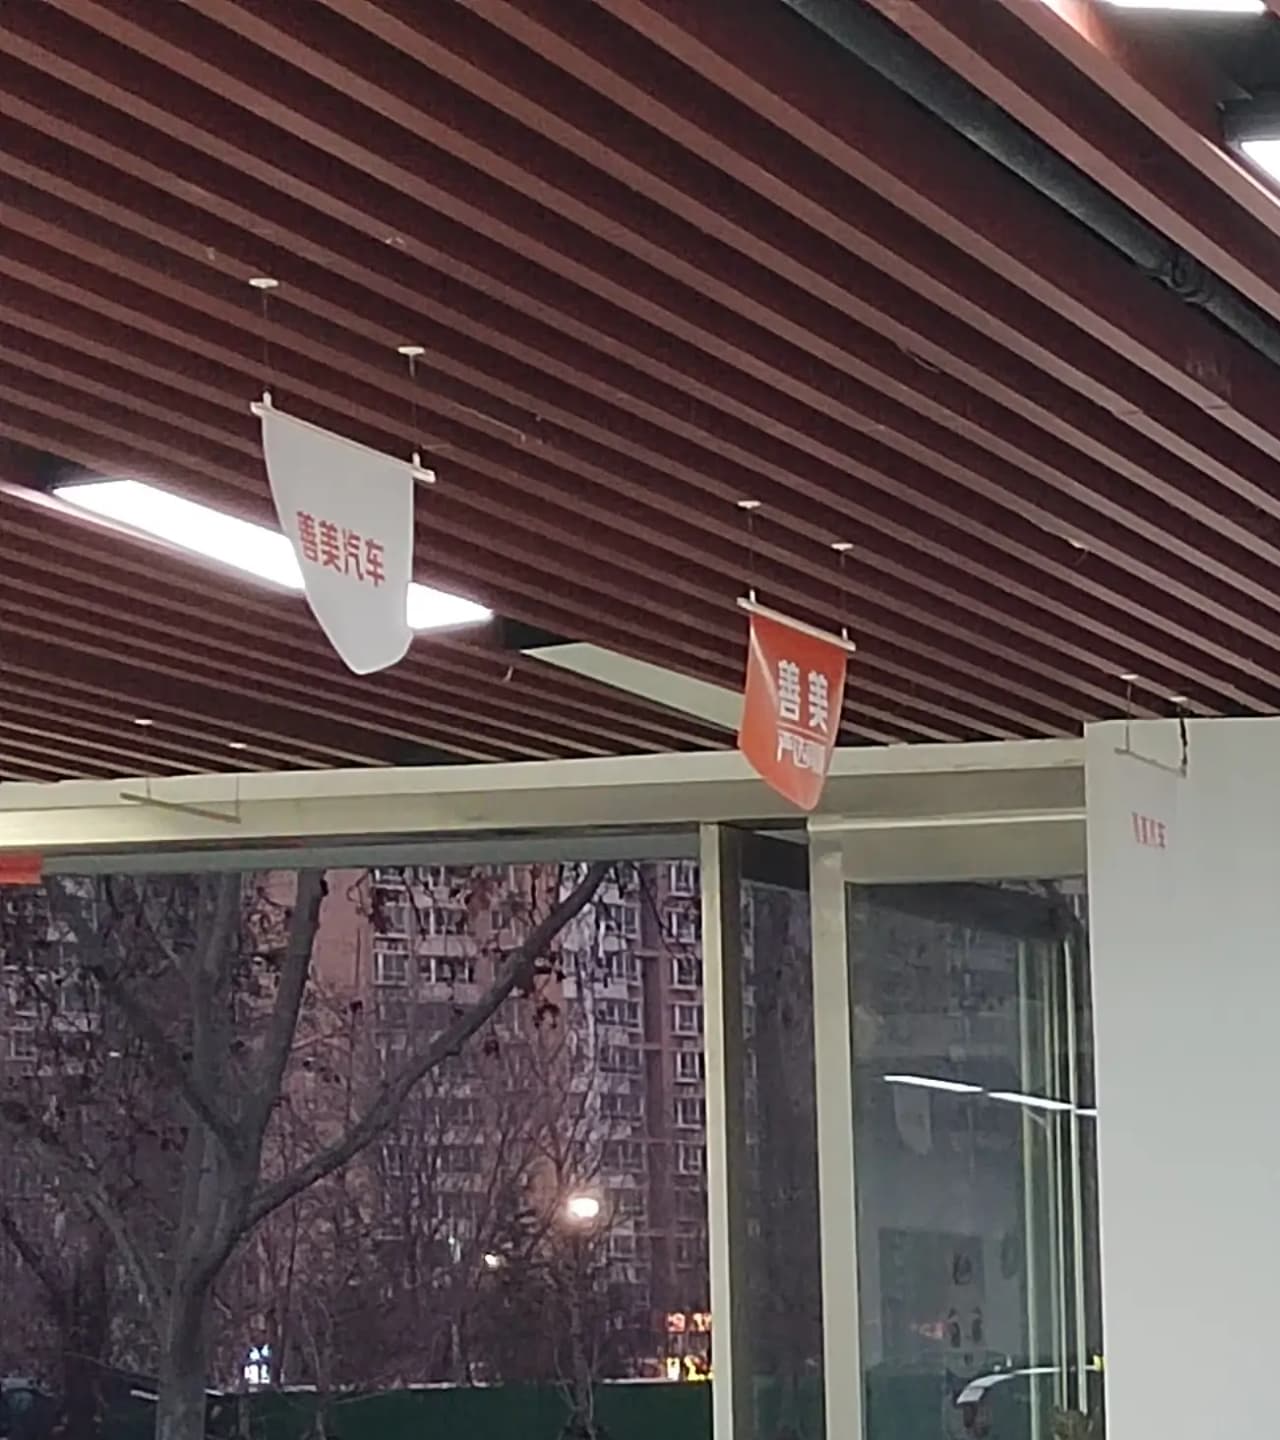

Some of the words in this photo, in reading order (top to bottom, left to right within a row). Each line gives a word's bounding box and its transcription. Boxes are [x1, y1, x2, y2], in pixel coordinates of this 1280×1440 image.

[296, 510, 385, 588] 善美汽车
[777, 658, 829, 734] 善美
